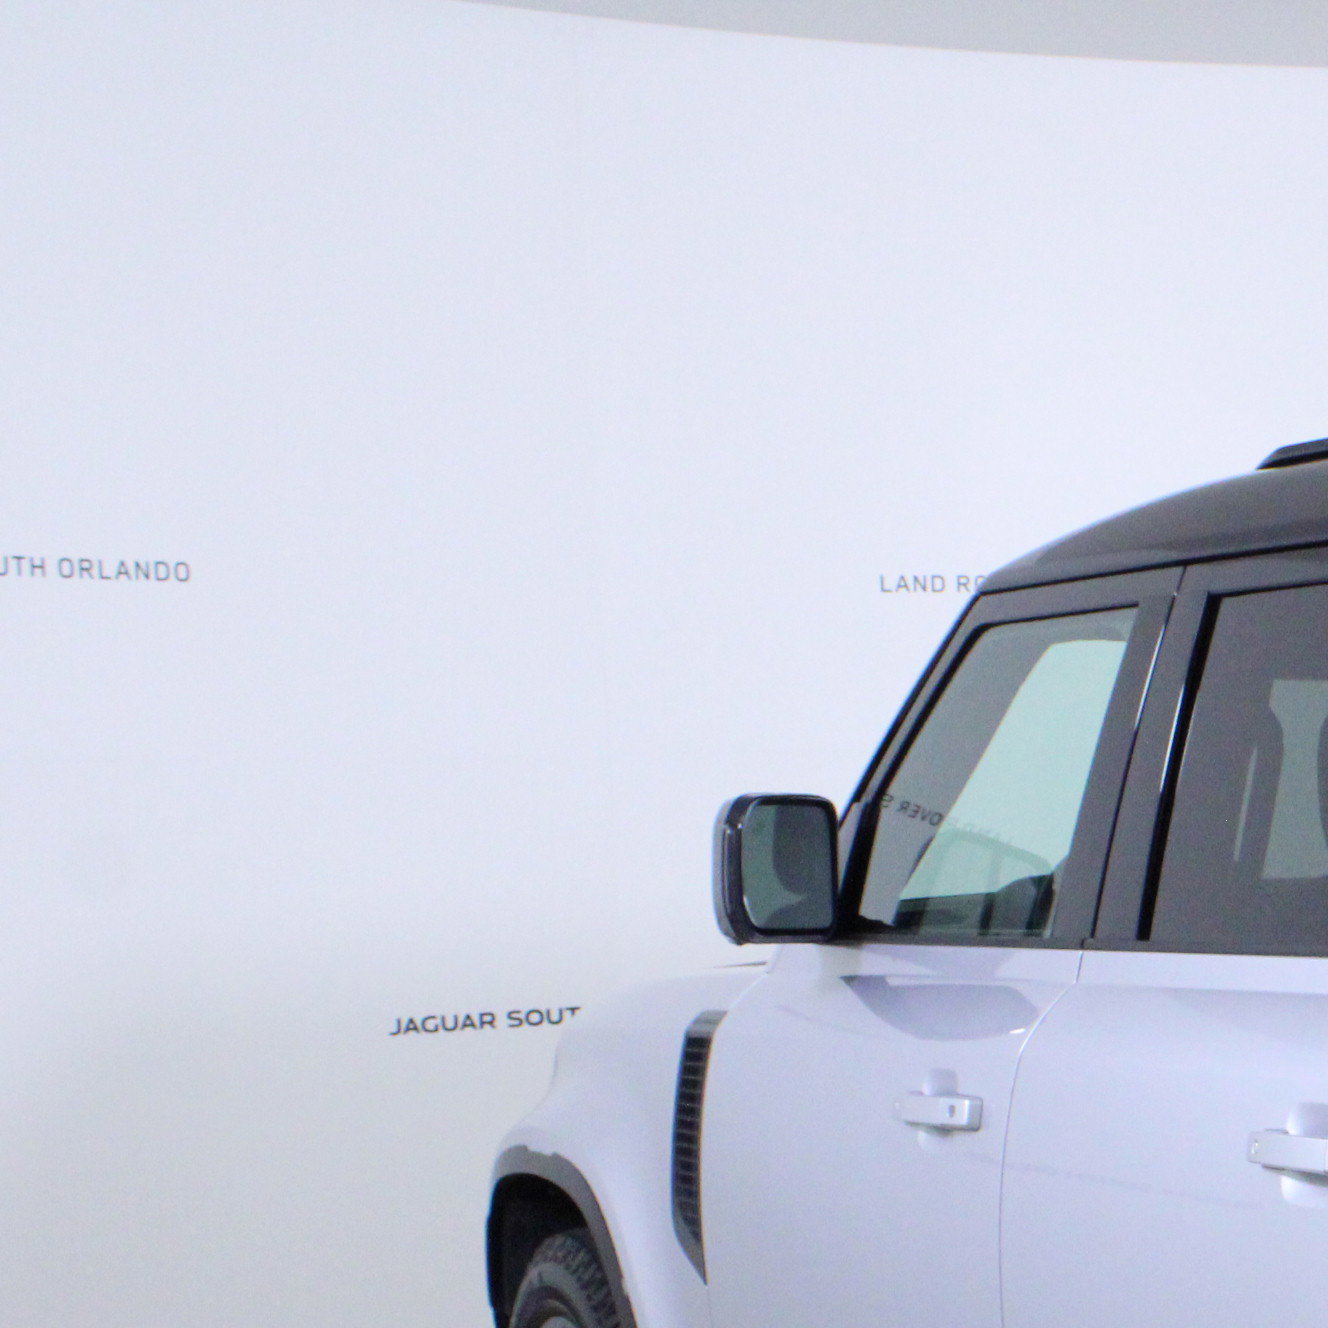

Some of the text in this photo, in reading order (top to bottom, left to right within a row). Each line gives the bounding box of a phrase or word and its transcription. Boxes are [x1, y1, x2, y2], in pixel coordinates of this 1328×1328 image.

[57, 557, 192, 582] ORLANDO
[879, 574, 946, 593] LAND
[389, 1011, 497, 1036] JAGUAR
